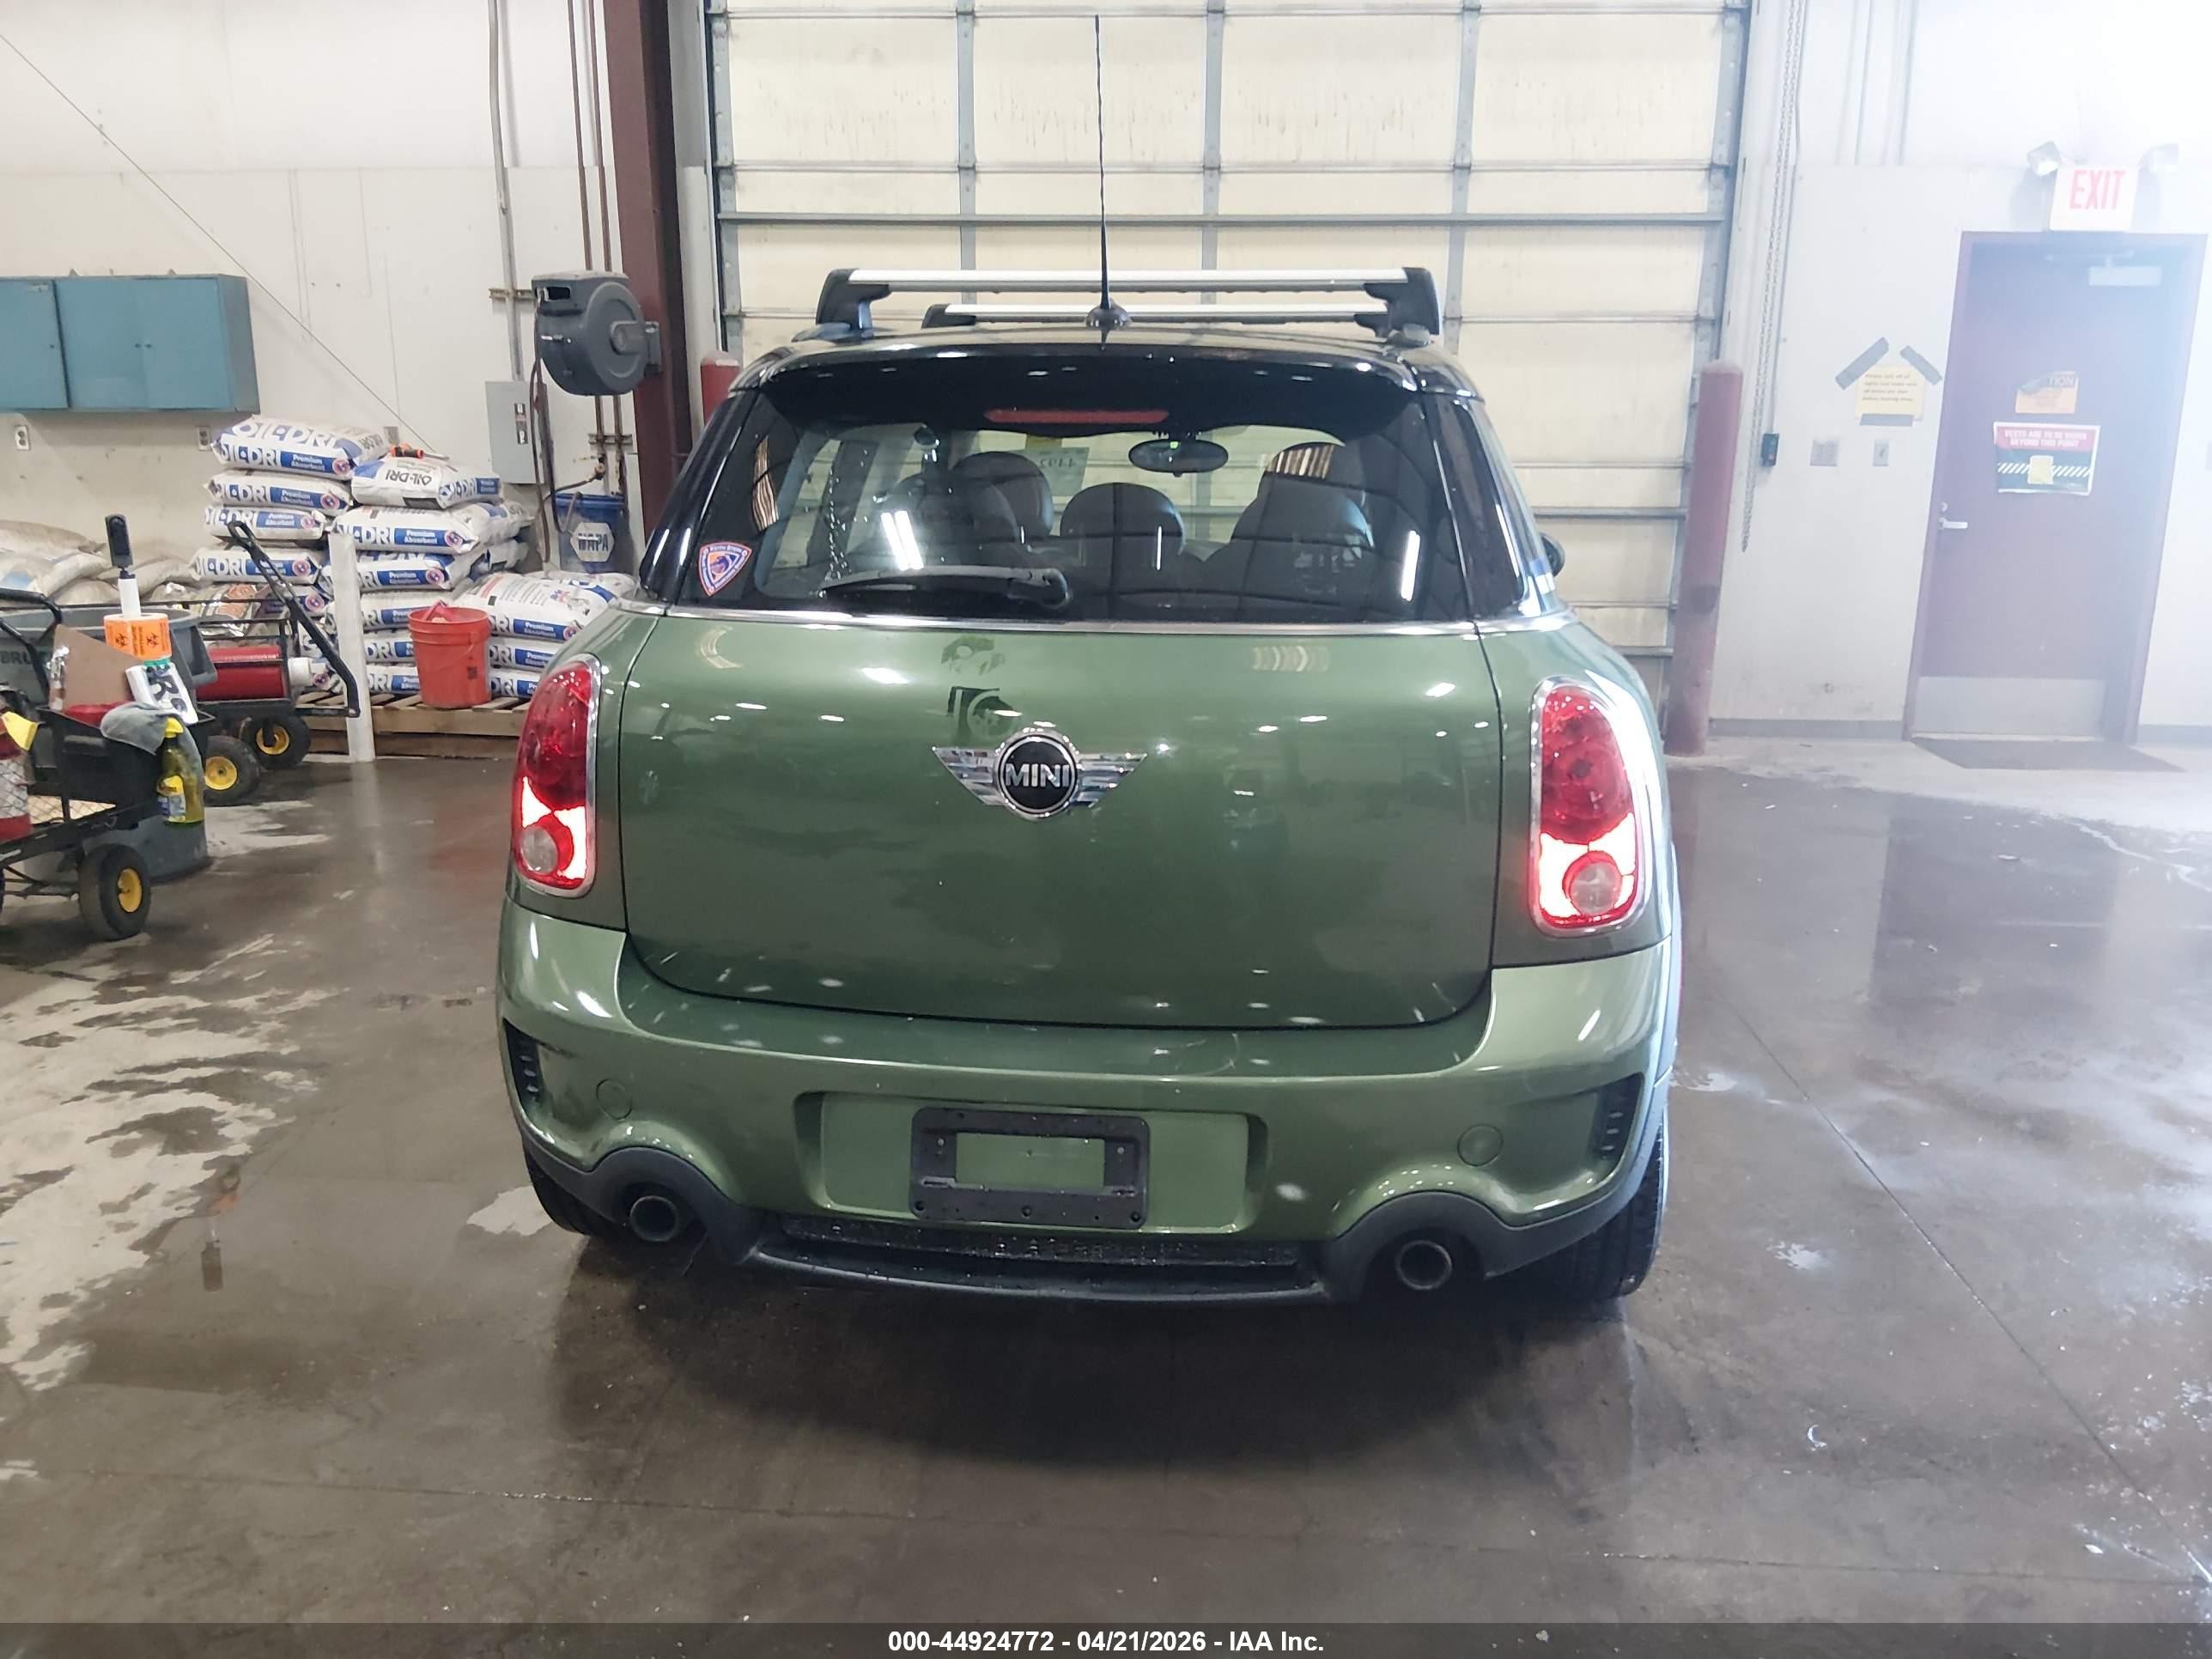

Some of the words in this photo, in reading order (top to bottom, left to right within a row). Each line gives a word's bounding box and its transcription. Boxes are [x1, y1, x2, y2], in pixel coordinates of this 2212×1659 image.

[2069, 169, 2125, 210] EXIT
[293, 453, 323, 465] Premium
[405, 529, 436, 538] Premium
[577, 532, 609, 552] NAPA
[1005, 763, 1070, 788] MINI
